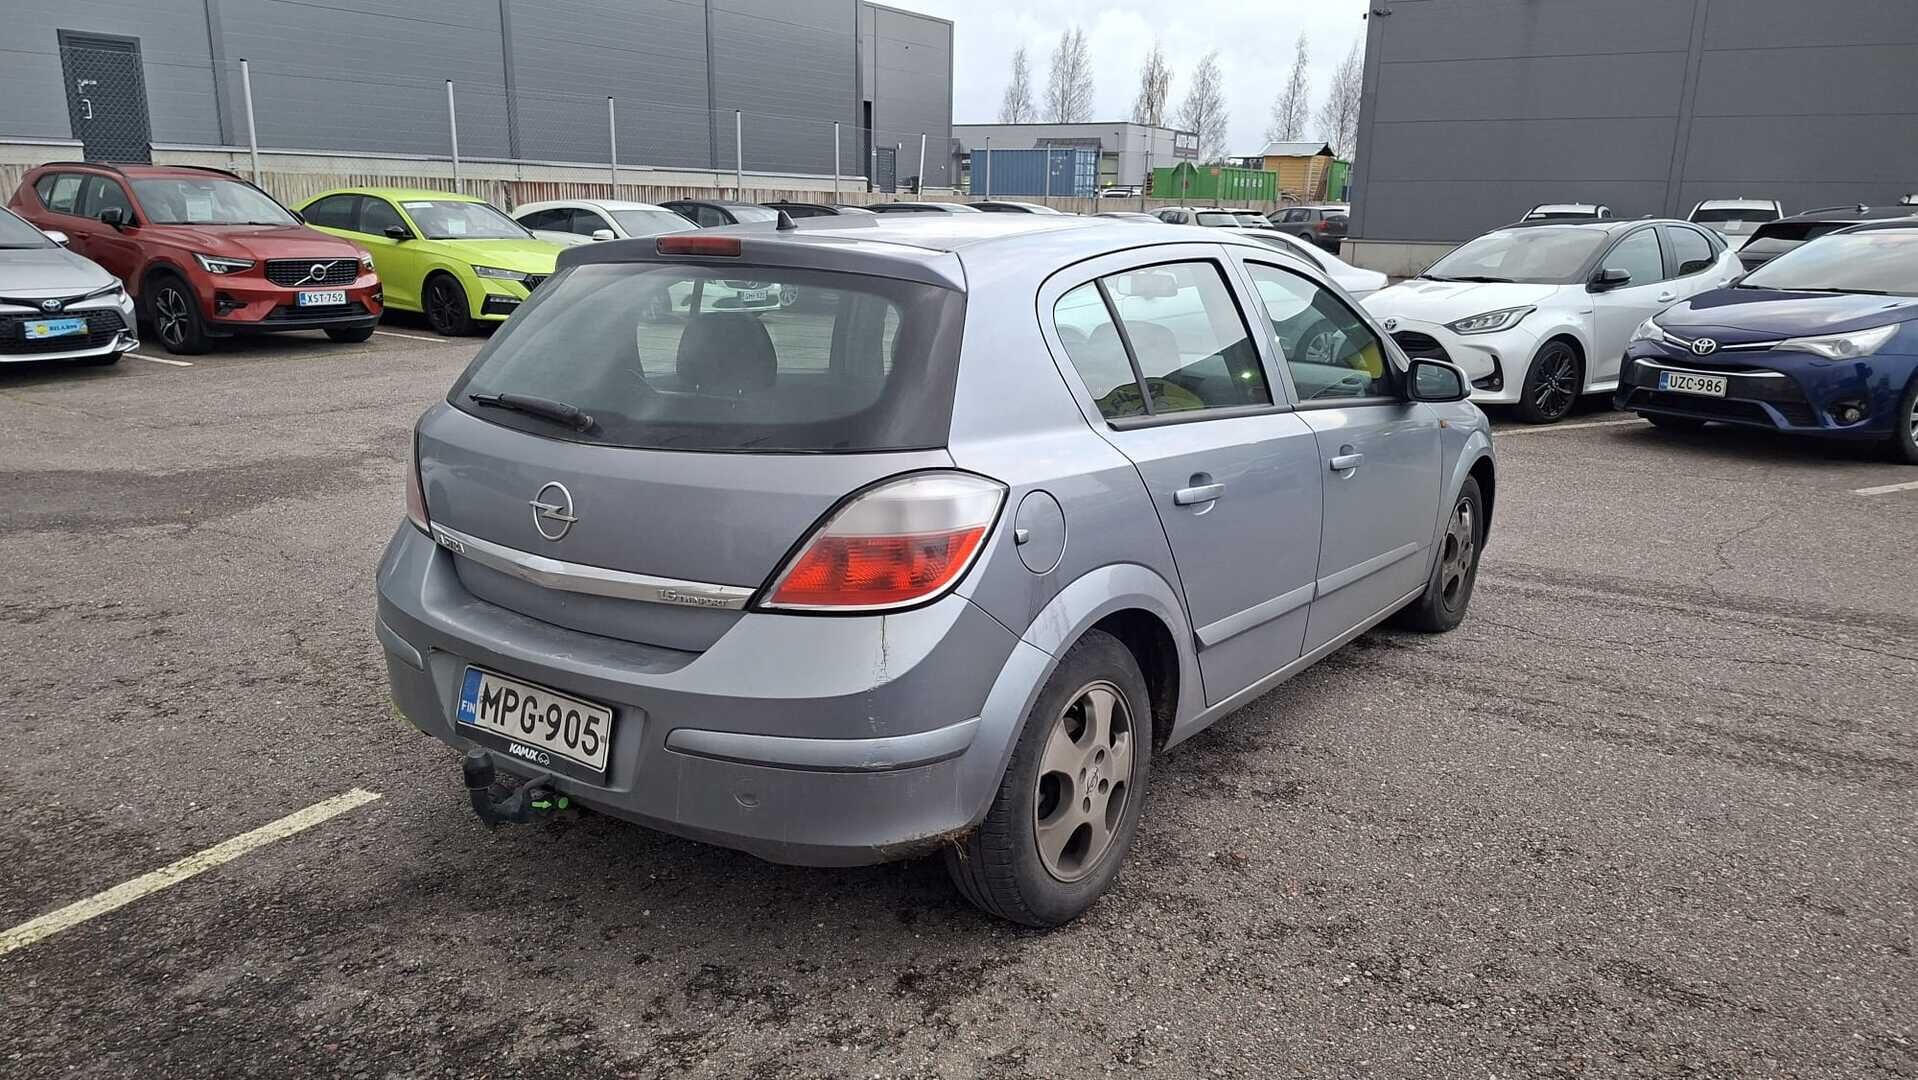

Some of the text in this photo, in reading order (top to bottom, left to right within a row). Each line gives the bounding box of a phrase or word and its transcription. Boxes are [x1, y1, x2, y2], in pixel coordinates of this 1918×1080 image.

[307, 293, 344, 303] XST-752
[1670, 375, 1722, 393] UZC-986
[461, 700, 476, 714] FIN
[480, 682, 600, 757] MPG-905
[509, 742, 538, 761] KAMUX
